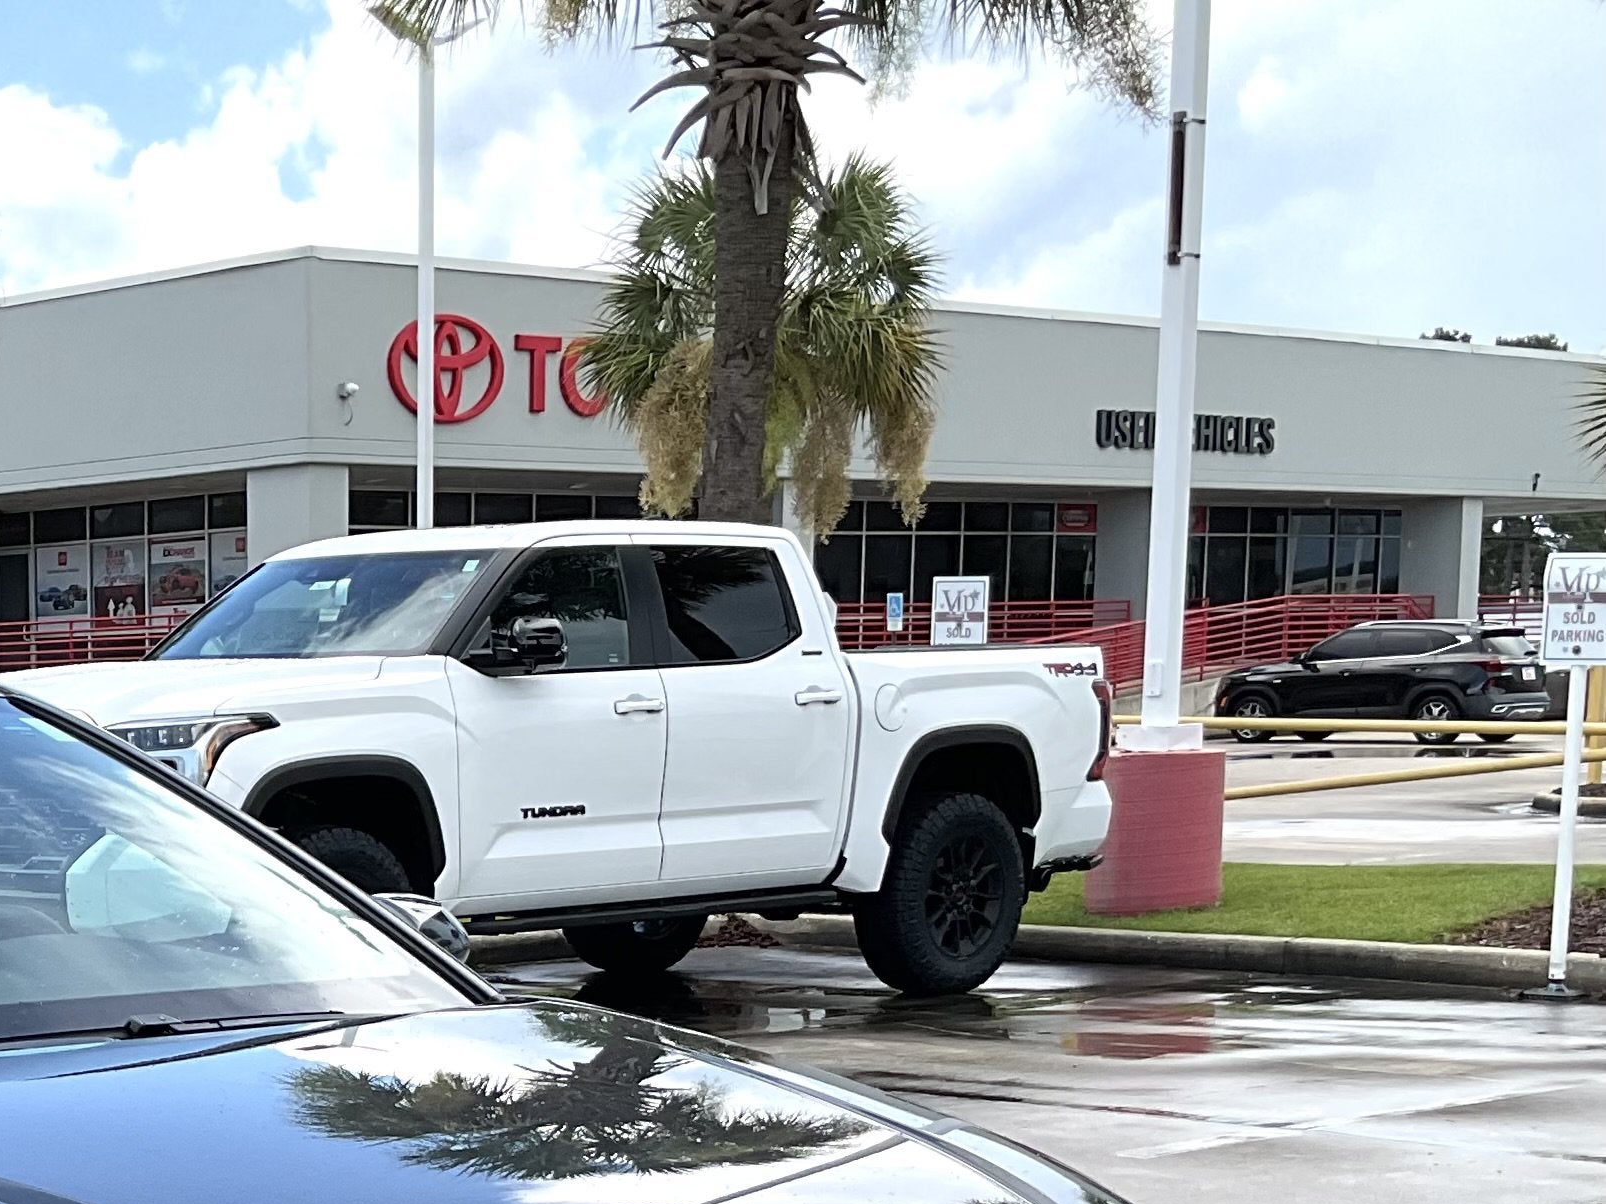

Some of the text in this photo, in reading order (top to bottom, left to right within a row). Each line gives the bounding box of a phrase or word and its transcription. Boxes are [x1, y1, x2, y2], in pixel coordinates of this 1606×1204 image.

[1191, 413, 1276, 455] HICLES
[1563, 611, 1595, 625] SOLD
[946, 627, 971, 638] SOLD
[1551, 629, 1604, 643] PARKING
[520, 804, 586, 819] TUNDRA
